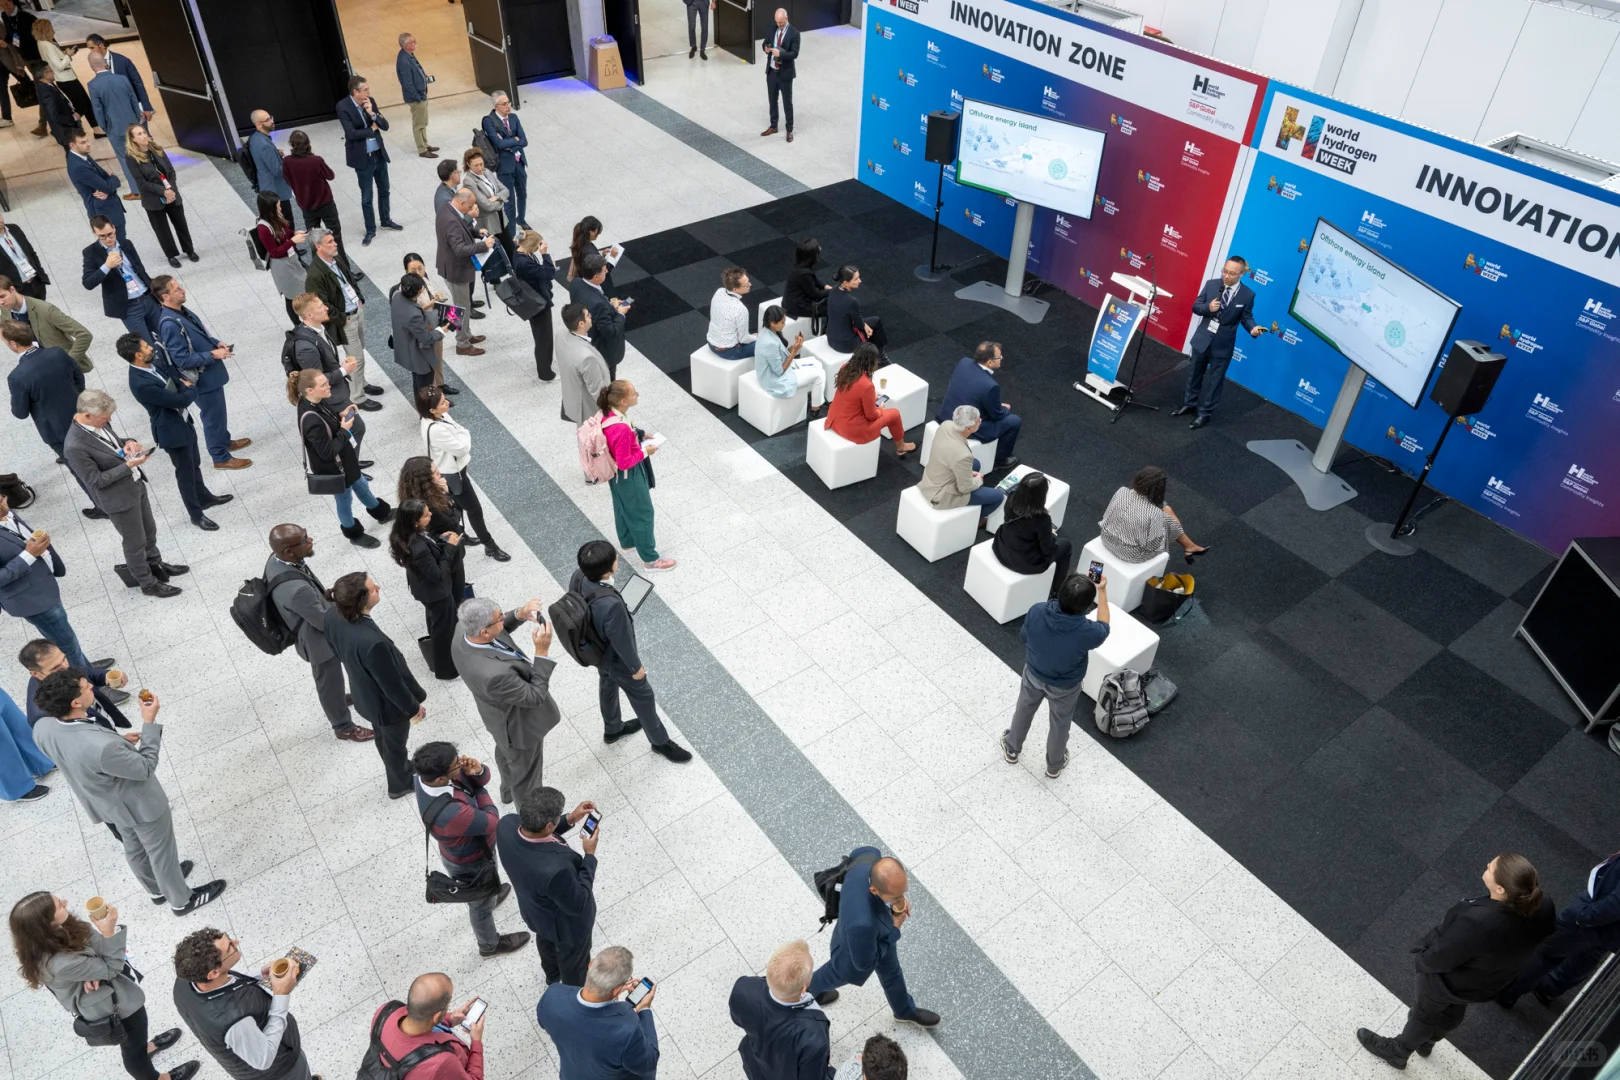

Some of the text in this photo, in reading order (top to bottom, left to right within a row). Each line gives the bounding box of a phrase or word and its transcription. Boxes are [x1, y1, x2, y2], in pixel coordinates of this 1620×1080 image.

[900, 0, 918, 13] WEEK
[950, 0, 1126, 81] INNOVATION ZONE
[1207, 87, 1225, 97] hydrogen
[1208, 83, 1220, 91] world
[1188, 101, 1216, 115] S&P Global
[968, 109, 1037, 131] Offshore energy island
[1186, 108, 1235, 131] Commodity Insights
[1327, 123, 1360, 142] world
[1322, 134, 1377, 162] hydrogen
[1319, 150, 1354, 173] WEEK
[1320, 232, 1386, 280] Offshore energy island
[1575, 321, 1602, 336] Commodity
[1526, 412, 1550, 428] Commodity
[1560, 483, 1585, 499] Commodity
[1480, 494, 1504, 509] Commodity
